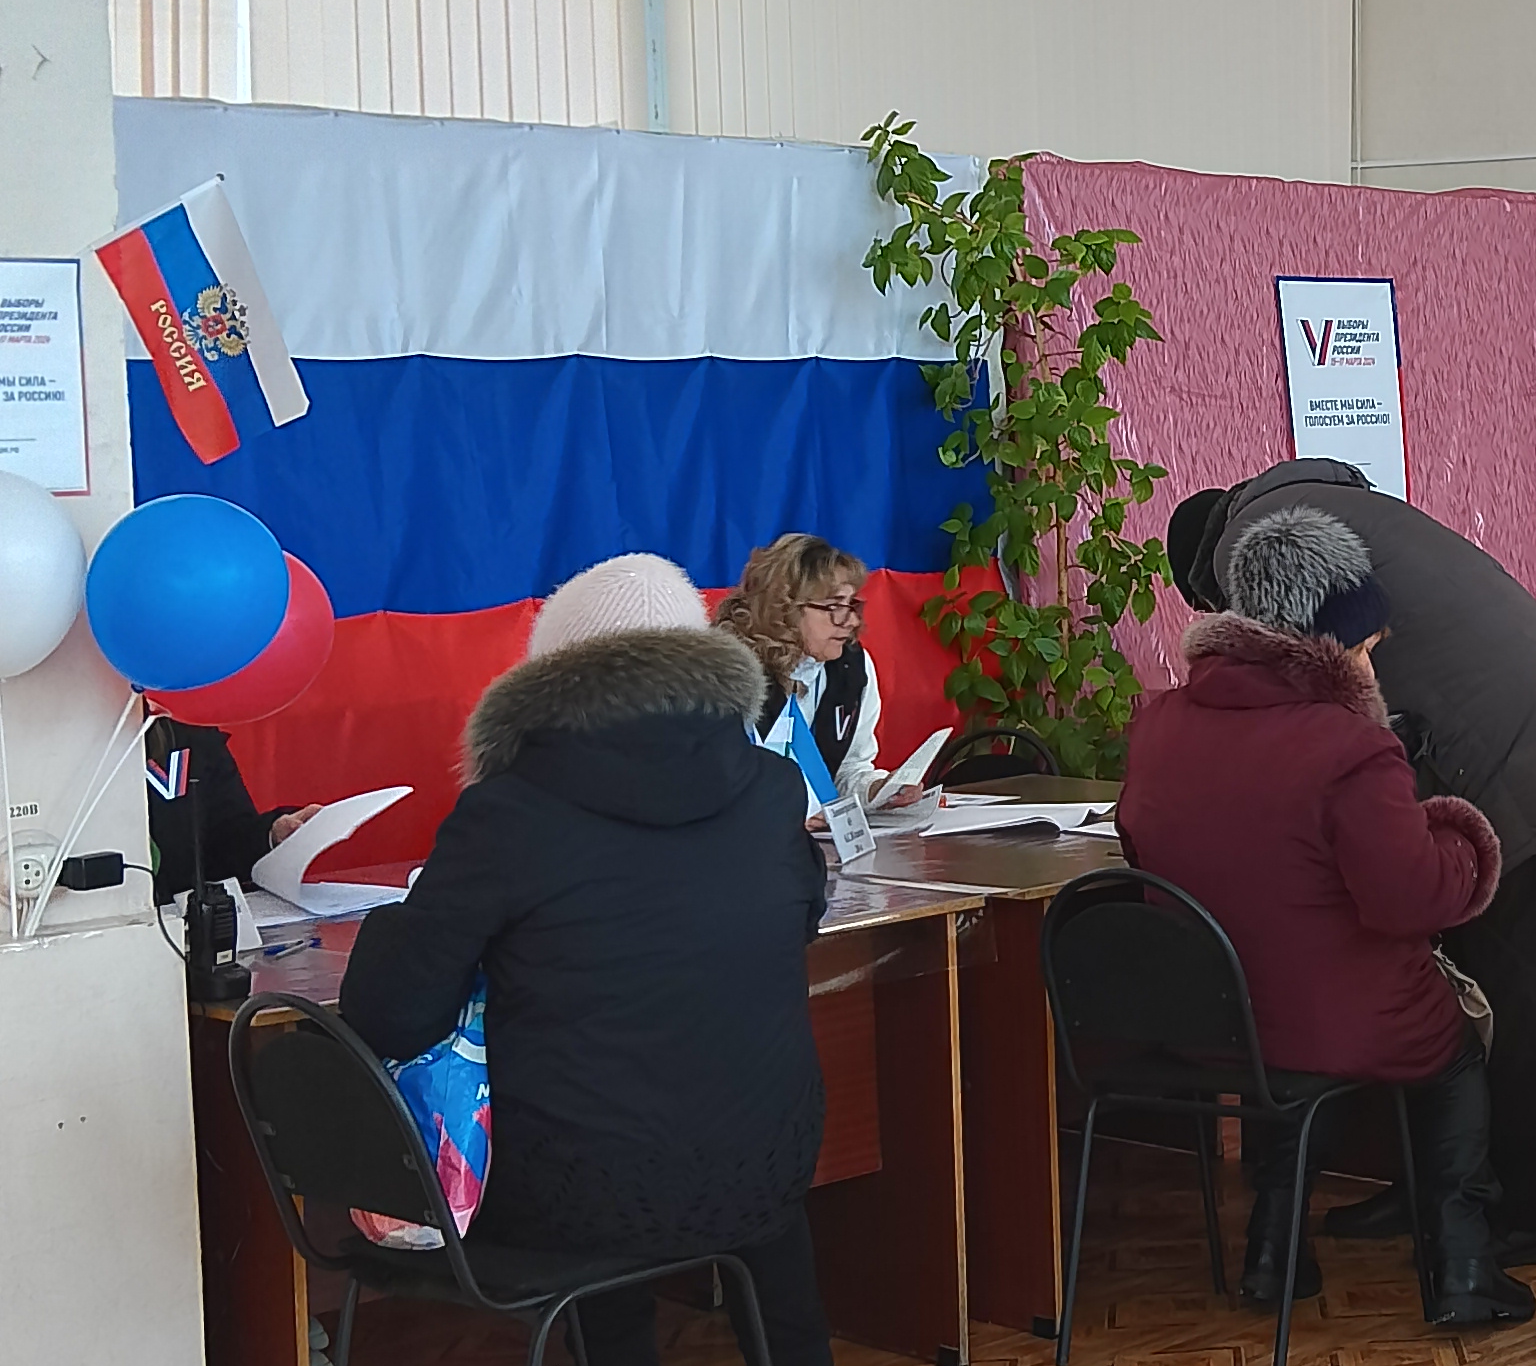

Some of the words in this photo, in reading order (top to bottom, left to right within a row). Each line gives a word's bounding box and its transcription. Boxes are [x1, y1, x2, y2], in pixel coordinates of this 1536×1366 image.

[1, 298, 45, 308] ВЫБОРЫ
[1337, 319, 1369, 329] ВЫБОРЫ
[1334, 332, 1380, 343] ПРЕЗИДЕНТА
[150, 299, 207, 392] РОССИЯ
[1332, 345, 1361, 355] РОССИИ
[19, 376, 46, 386] СИЛА
[3, 391, 15, 401] ЗА
[18, 390, 65, 401] РОССИЮ!
[1309, 399, 1339, 411] ВМЕСТЕ
[1356, 398, 1376, 410] СИЛА
[1305, 415, 1344, 427] ГОЛОСУЕМ
[1356, 413, 1390, 425] РОССИЮ!
